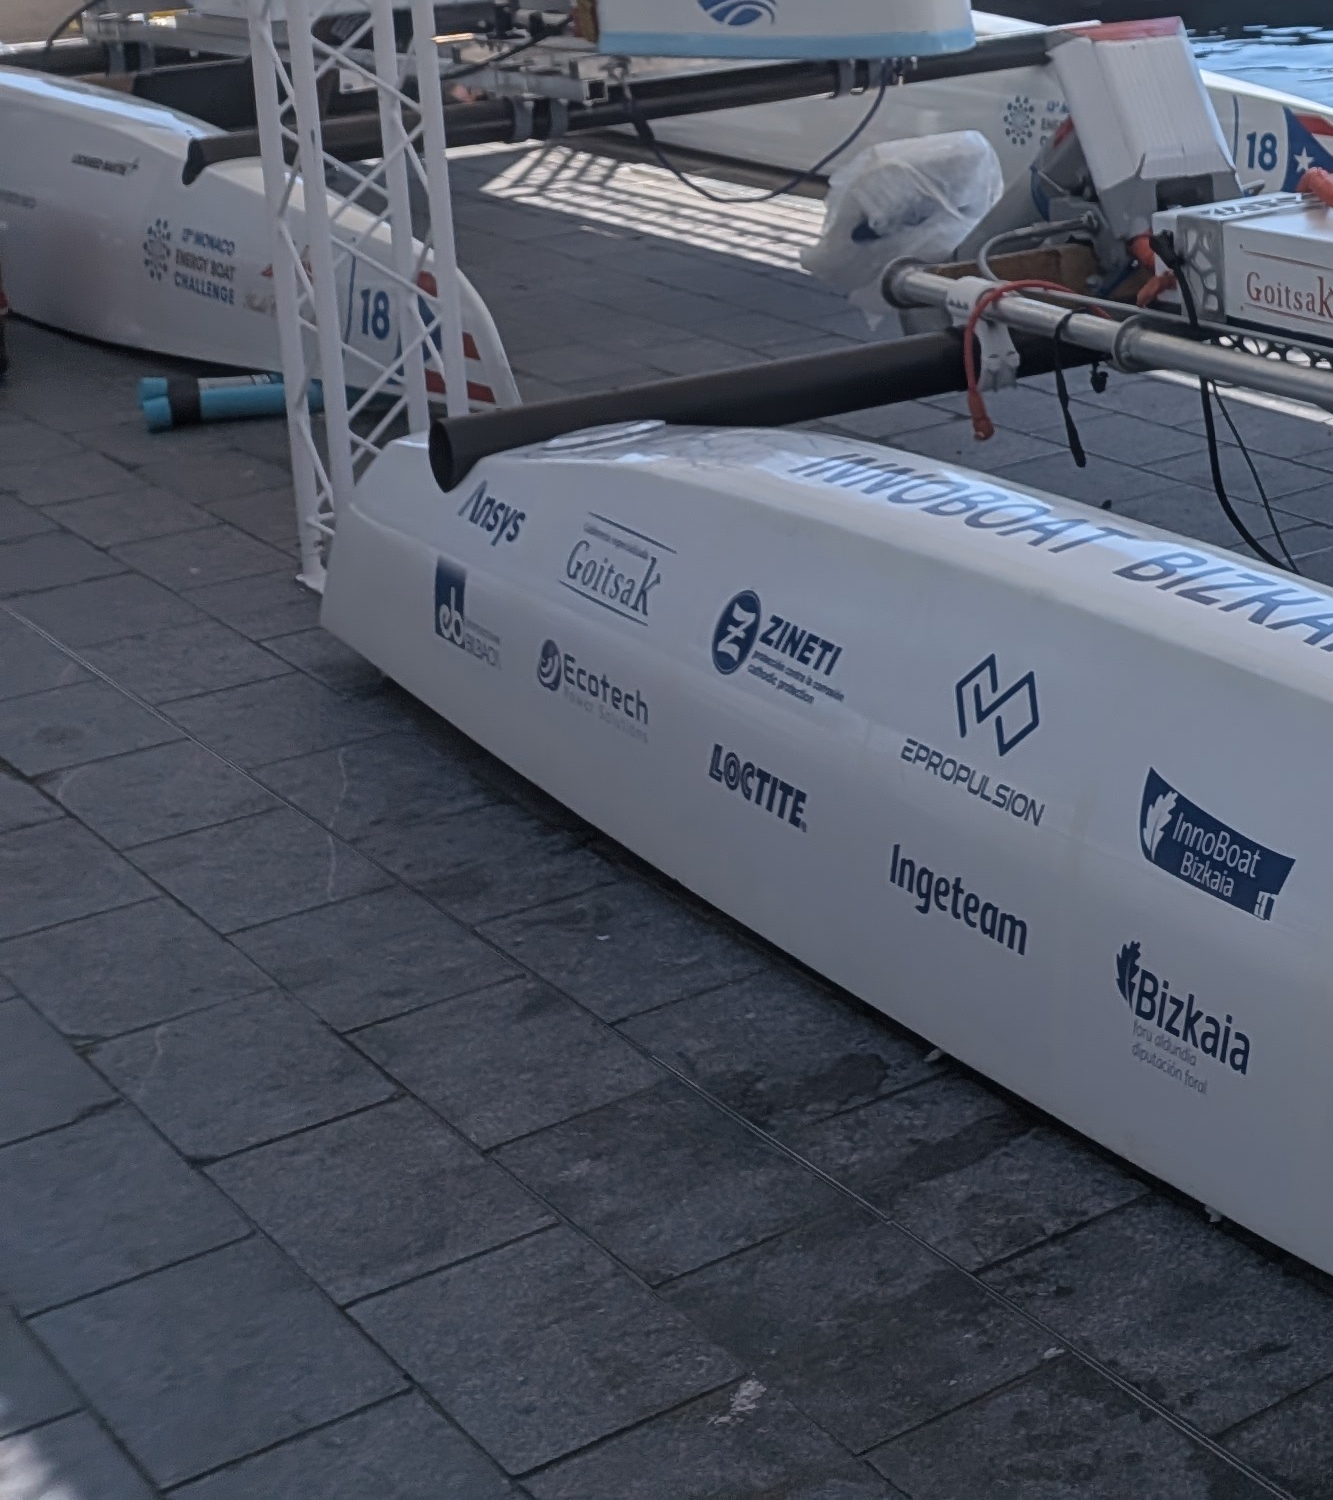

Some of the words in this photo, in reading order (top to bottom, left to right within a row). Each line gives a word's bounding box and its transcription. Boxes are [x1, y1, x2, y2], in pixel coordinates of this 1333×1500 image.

[1246, 131, 1279, 171] 18
[173, 270, 236, 306] CHALLENGE
[360, 288, 391, 341] 18
[457, 479, 526, 546] Ansys
[788, 452, 1138, 554] INNOBOAT
[758, 614, 843, 676] ZINETI
[563, 653, 648, 724] Ecotech
[899, 737, 1046, 827] EPROPULSION
[1172, 811, 1262, 878] InnoBoat
[1179, 850, 1235, 898] Bizkaia
[889, 843, 1028, 956] Ingeteam
[1135, 967, 1251, 1076] Bizkaia
